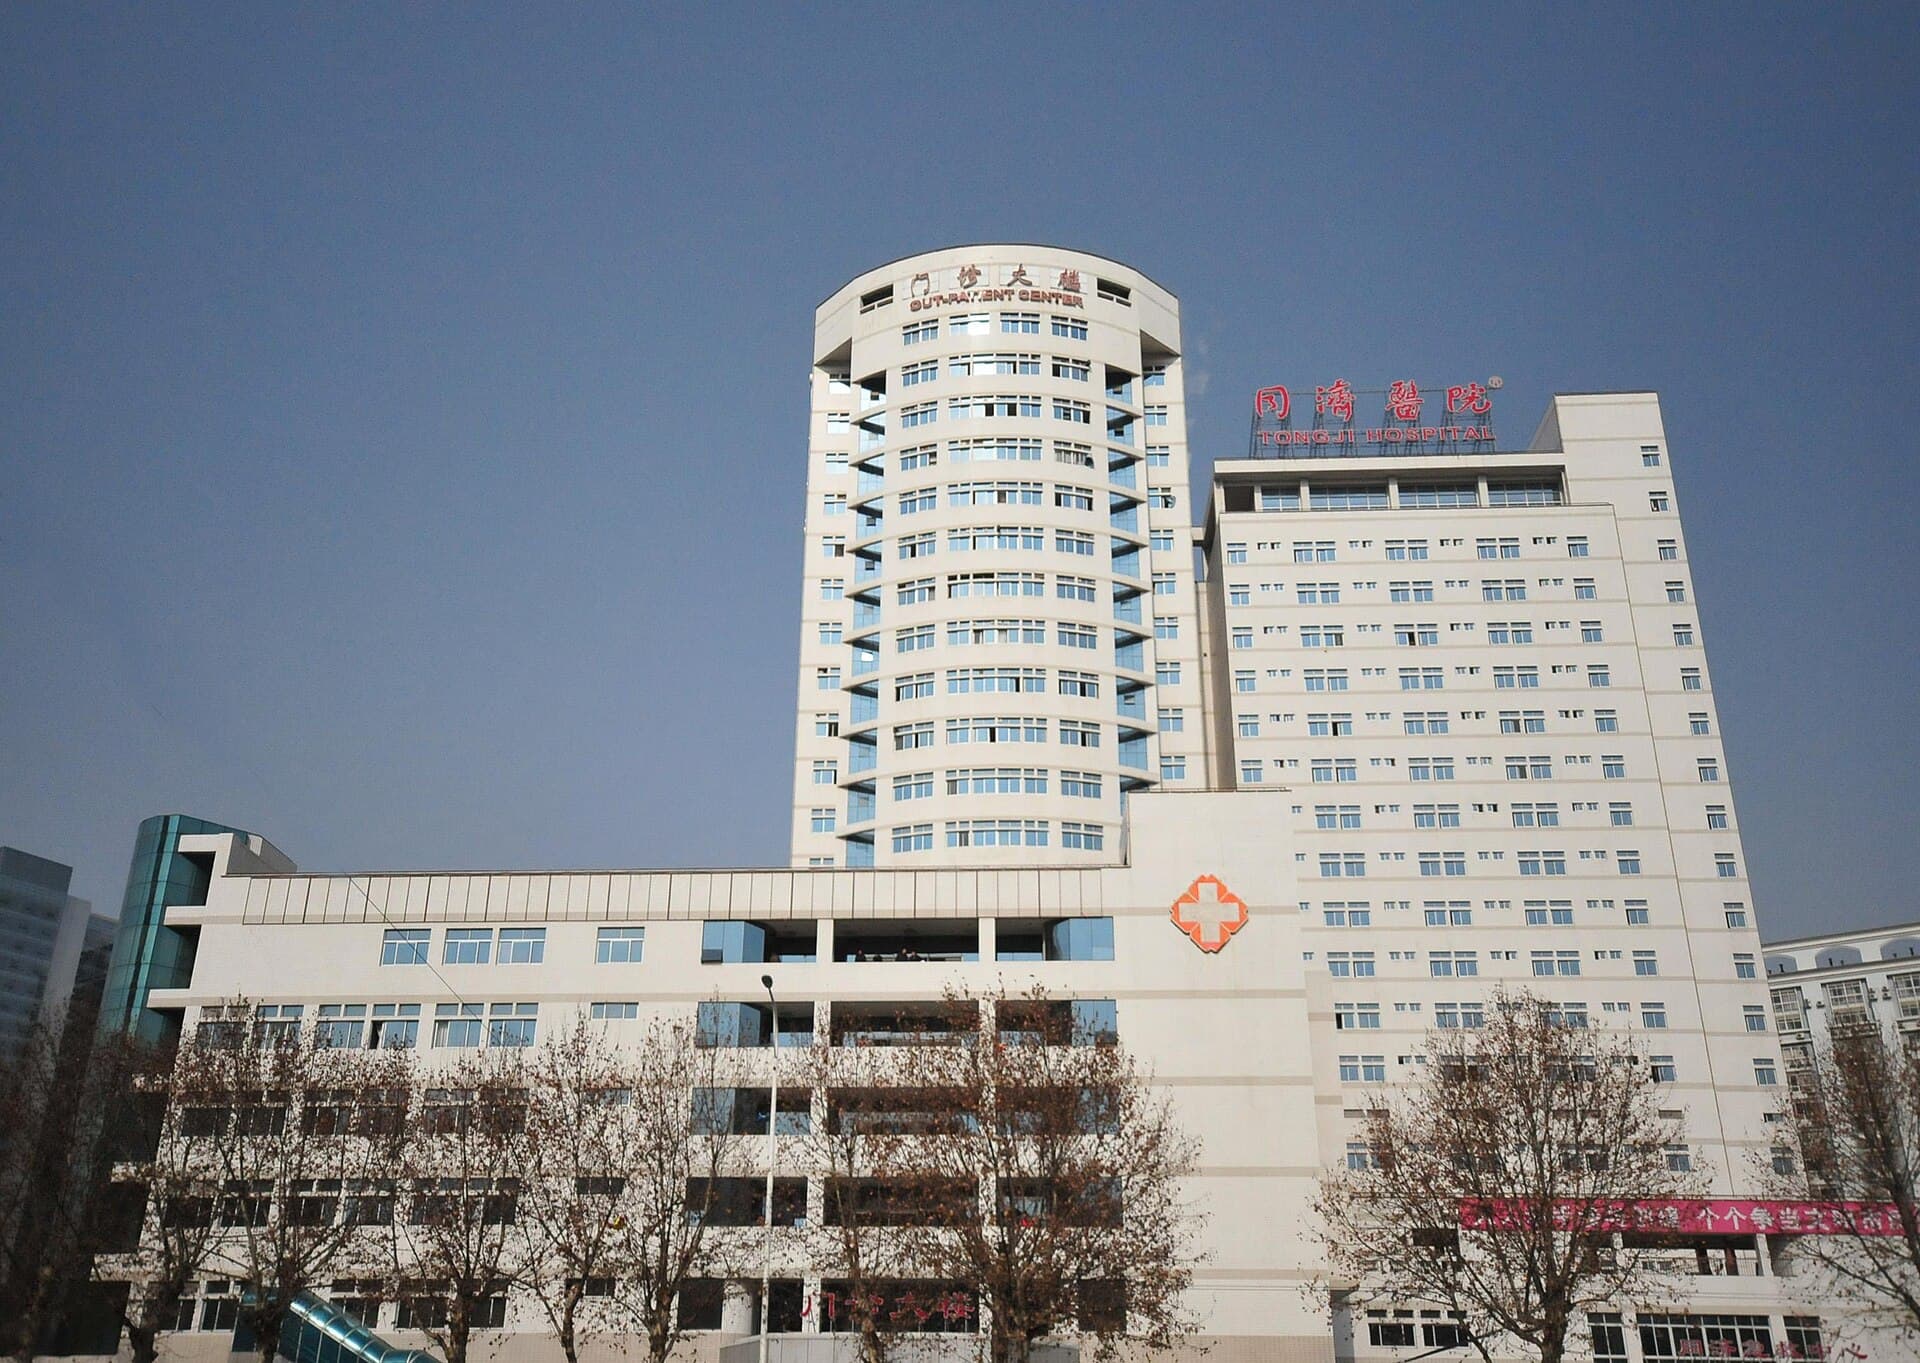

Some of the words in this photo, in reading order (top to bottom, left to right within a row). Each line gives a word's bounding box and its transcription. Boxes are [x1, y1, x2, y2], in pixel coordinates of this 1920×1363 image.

[910, 289, 1015, 312] OUT-PATIENT
[1019, 289, 1084, 309] CENTER
[1258, 430, 1354, 445] TONGJI
[1366, 425, 1496, 442] HOSPITAL
